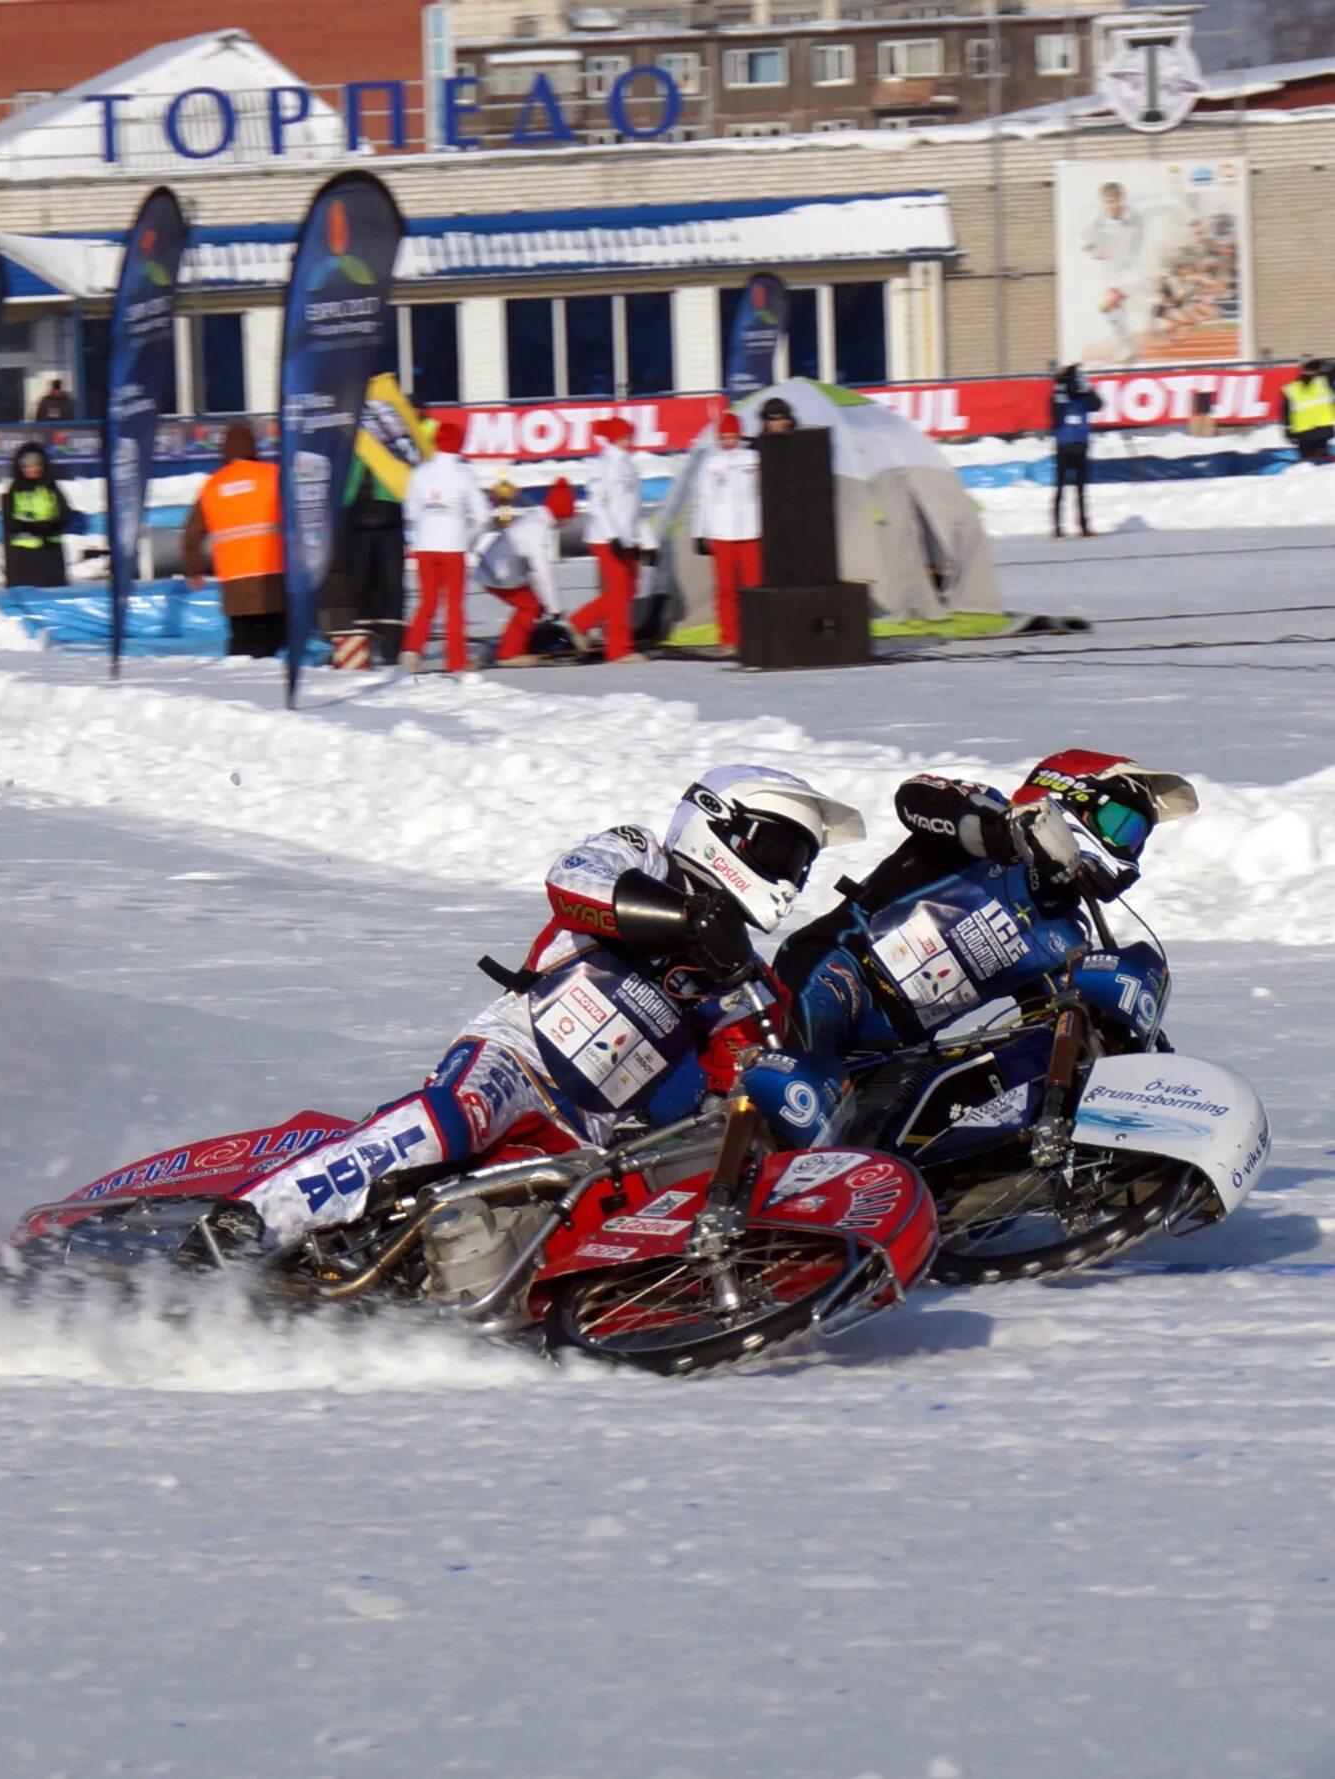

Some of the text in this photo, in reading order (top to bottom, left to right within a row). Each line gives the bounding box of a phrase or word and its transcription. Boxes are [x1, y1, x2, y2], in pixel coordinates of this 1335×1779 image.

[84, 65, 680, 163] ТОРПЕДО
[904, 807, 956, 836] WACO
[712, 856, 752, 893] Castrol
[558, 896, 617, 932] WAC
[979, 897, 1031, 963] ICE
[571, 988, 605, 1021] MOTUL
[1115, 973, 1158, 1034] 19
[630, 1052, 654, 1075] TISSOT
[1145, 1078, 1202, 1098] Ö-viks
[295, 1115, 428, 1214] LADA
[1231, 1146, 1263, 1189] Ö-viks
